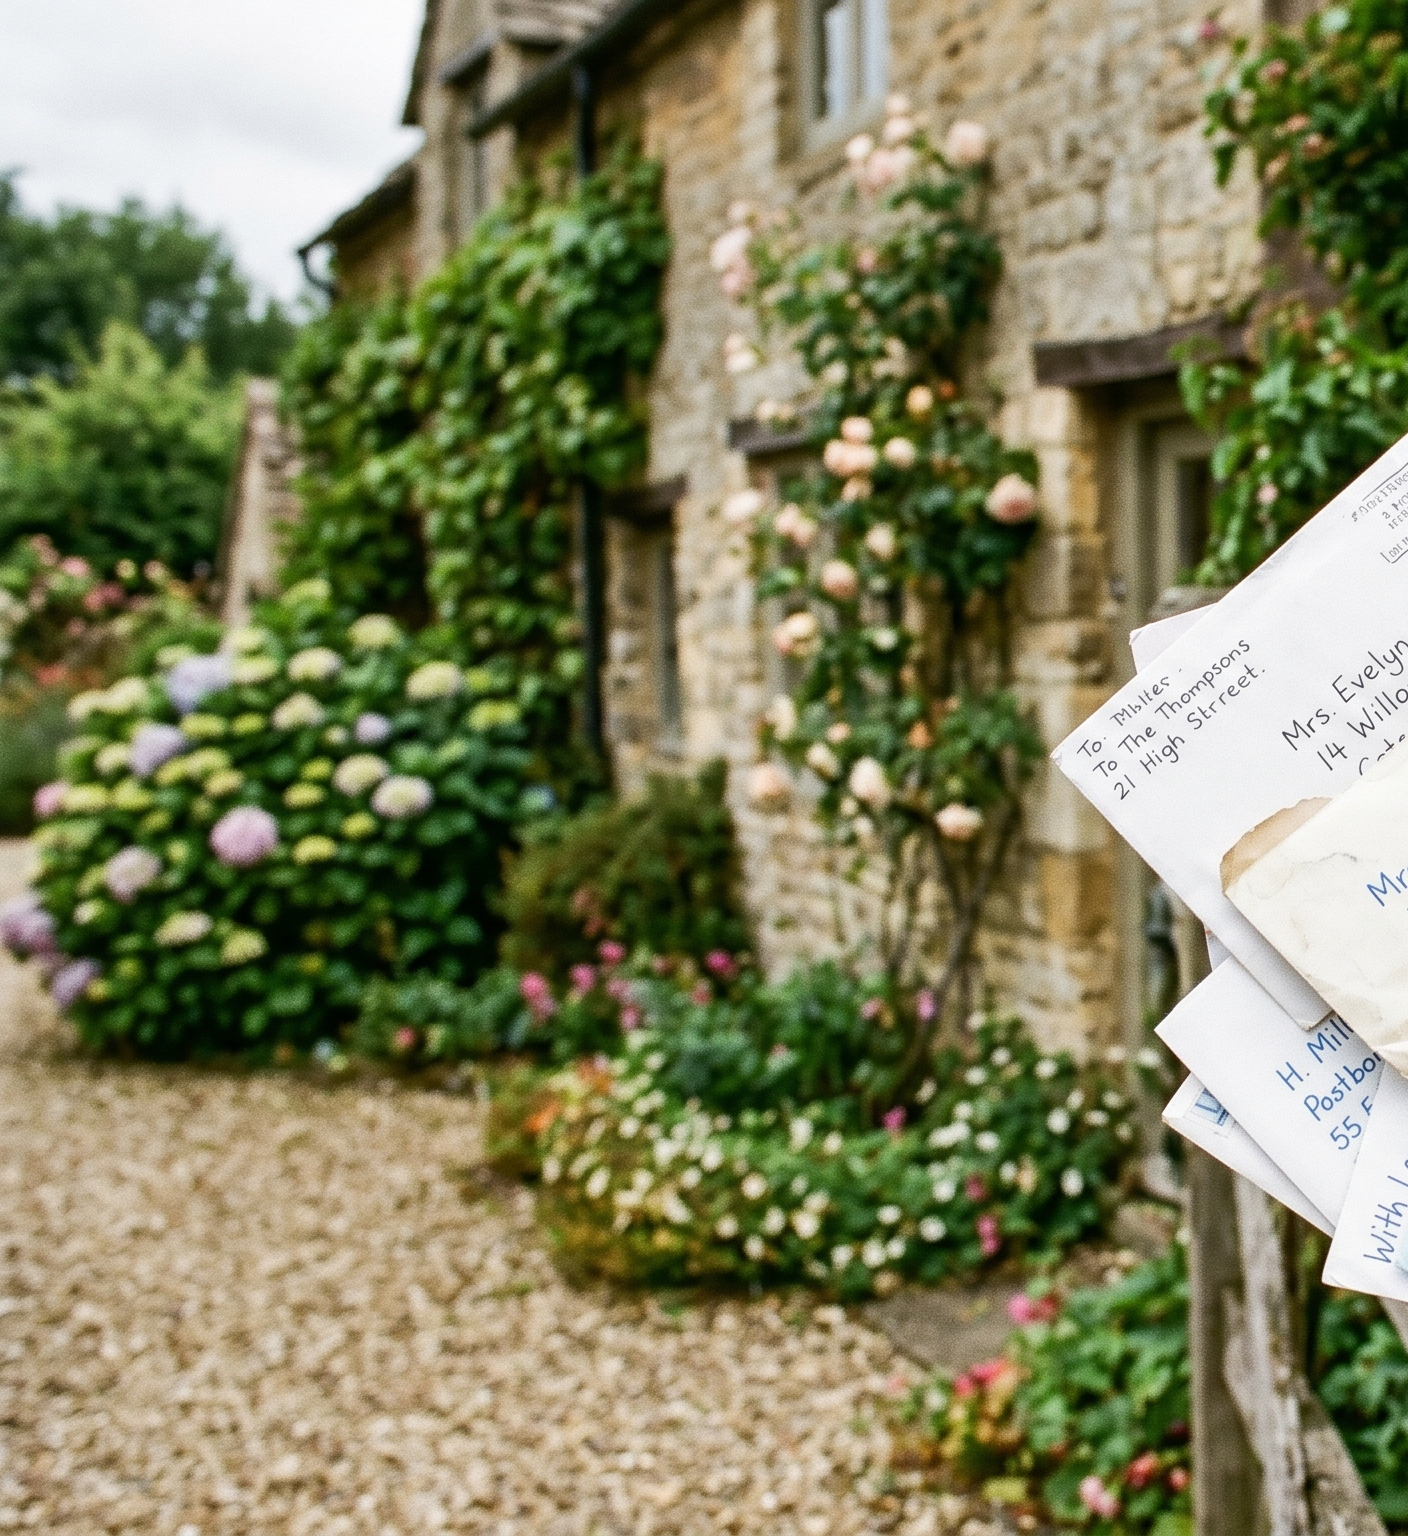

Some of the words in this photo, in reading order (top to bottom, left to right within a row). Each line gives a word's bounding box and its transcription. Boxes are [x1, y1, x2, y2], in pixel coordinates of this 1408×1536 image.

[1092, 760, 1118, 778] To
[1117, 726, 1157, 754] The
[1154, 639, 1251, 720] Thompsons
[1281, 707, 1337, 751] Mrs.
[1113, 774, 1136, 801] 21
[1139, 734, 1186, 775] High
[1316, 742, 1348, 771] 14
[1275, 1061, 1311, 1091] H.
[1329, 1115, 1363, 1151] 55
[1363, 1201, 1408, 1264] With
